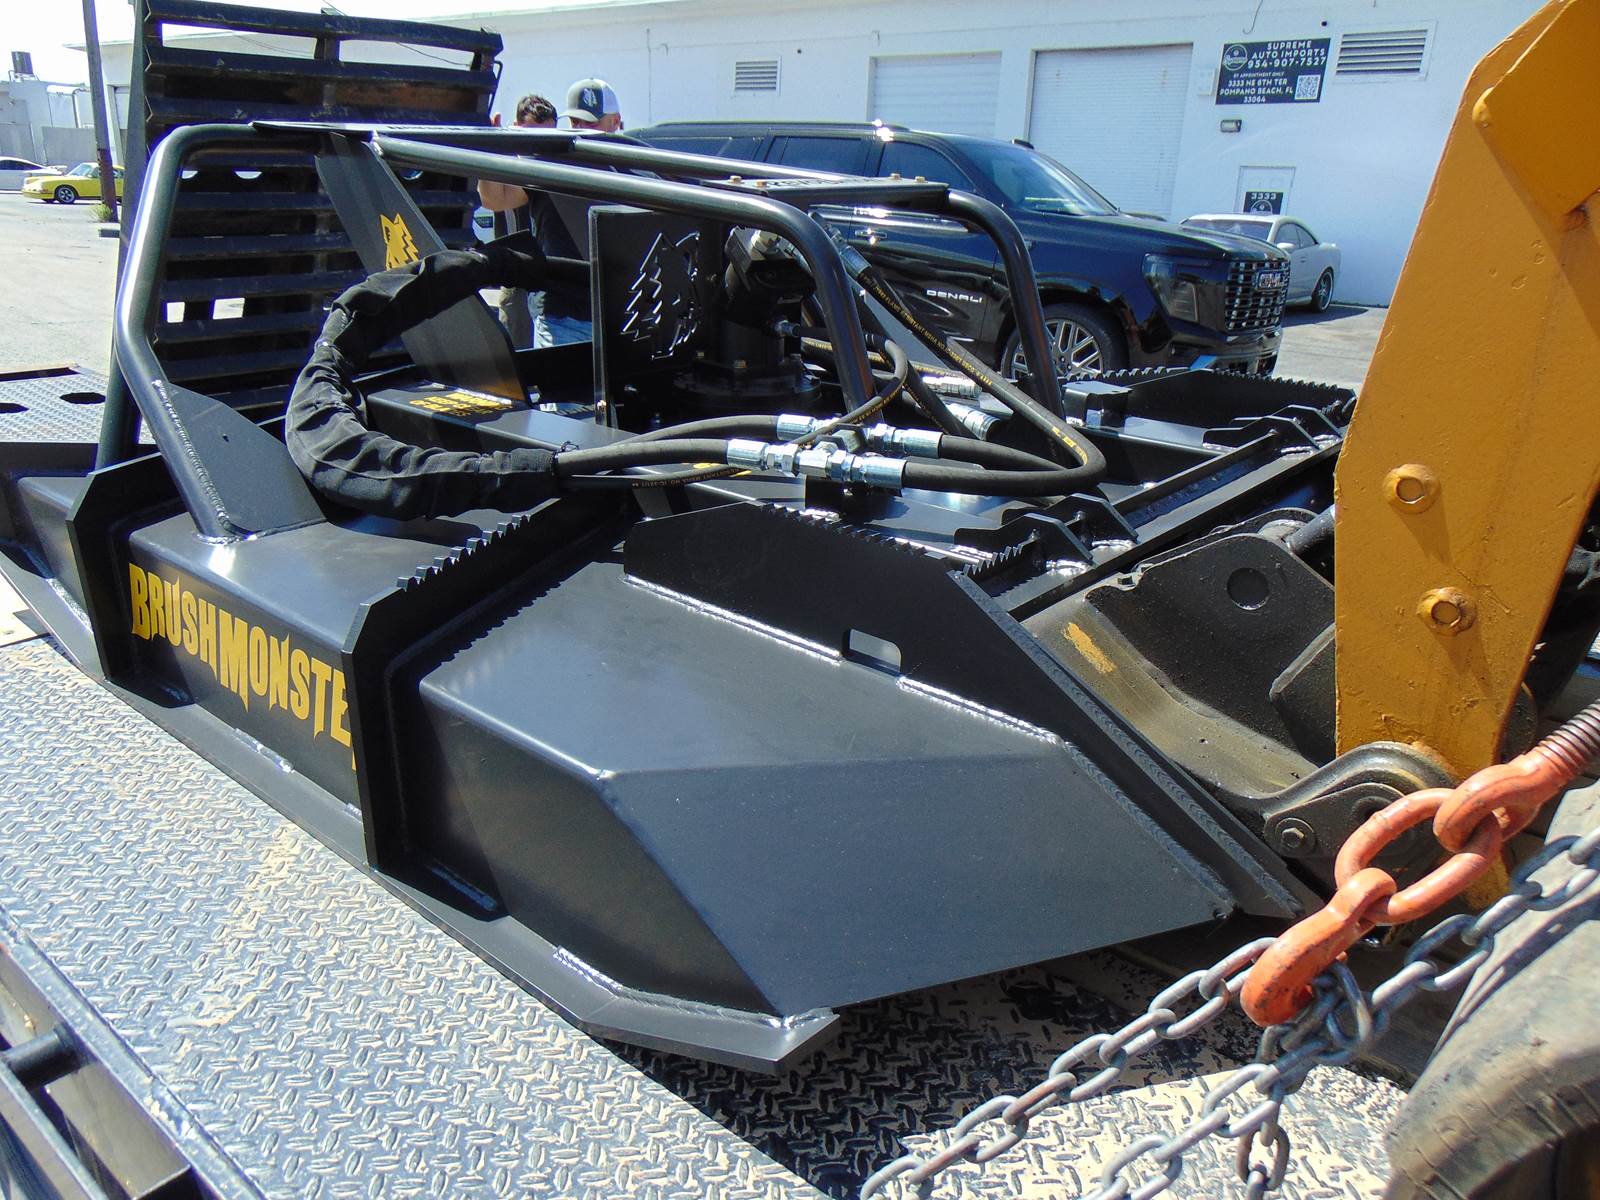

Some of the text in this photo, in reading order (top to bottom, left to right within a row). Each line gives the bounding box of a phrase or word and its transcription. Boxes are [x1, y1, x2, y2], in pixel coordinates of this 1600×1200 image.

[1267, 41, 1312, 50] SUPREME
[1251, 48, 1326, 59] AUTO IMPORTS
[1247, 57, 1327, 69] 954-907-7527
[1219, 87, 1256, 96] POMPANO
[1285, 86, 1294, 94] FL
[1251, 192, 1277, 200] 3333
[926, 289, 983, 303] DENALI
[128, 563, 357, 772] BRUSHMONSTE
